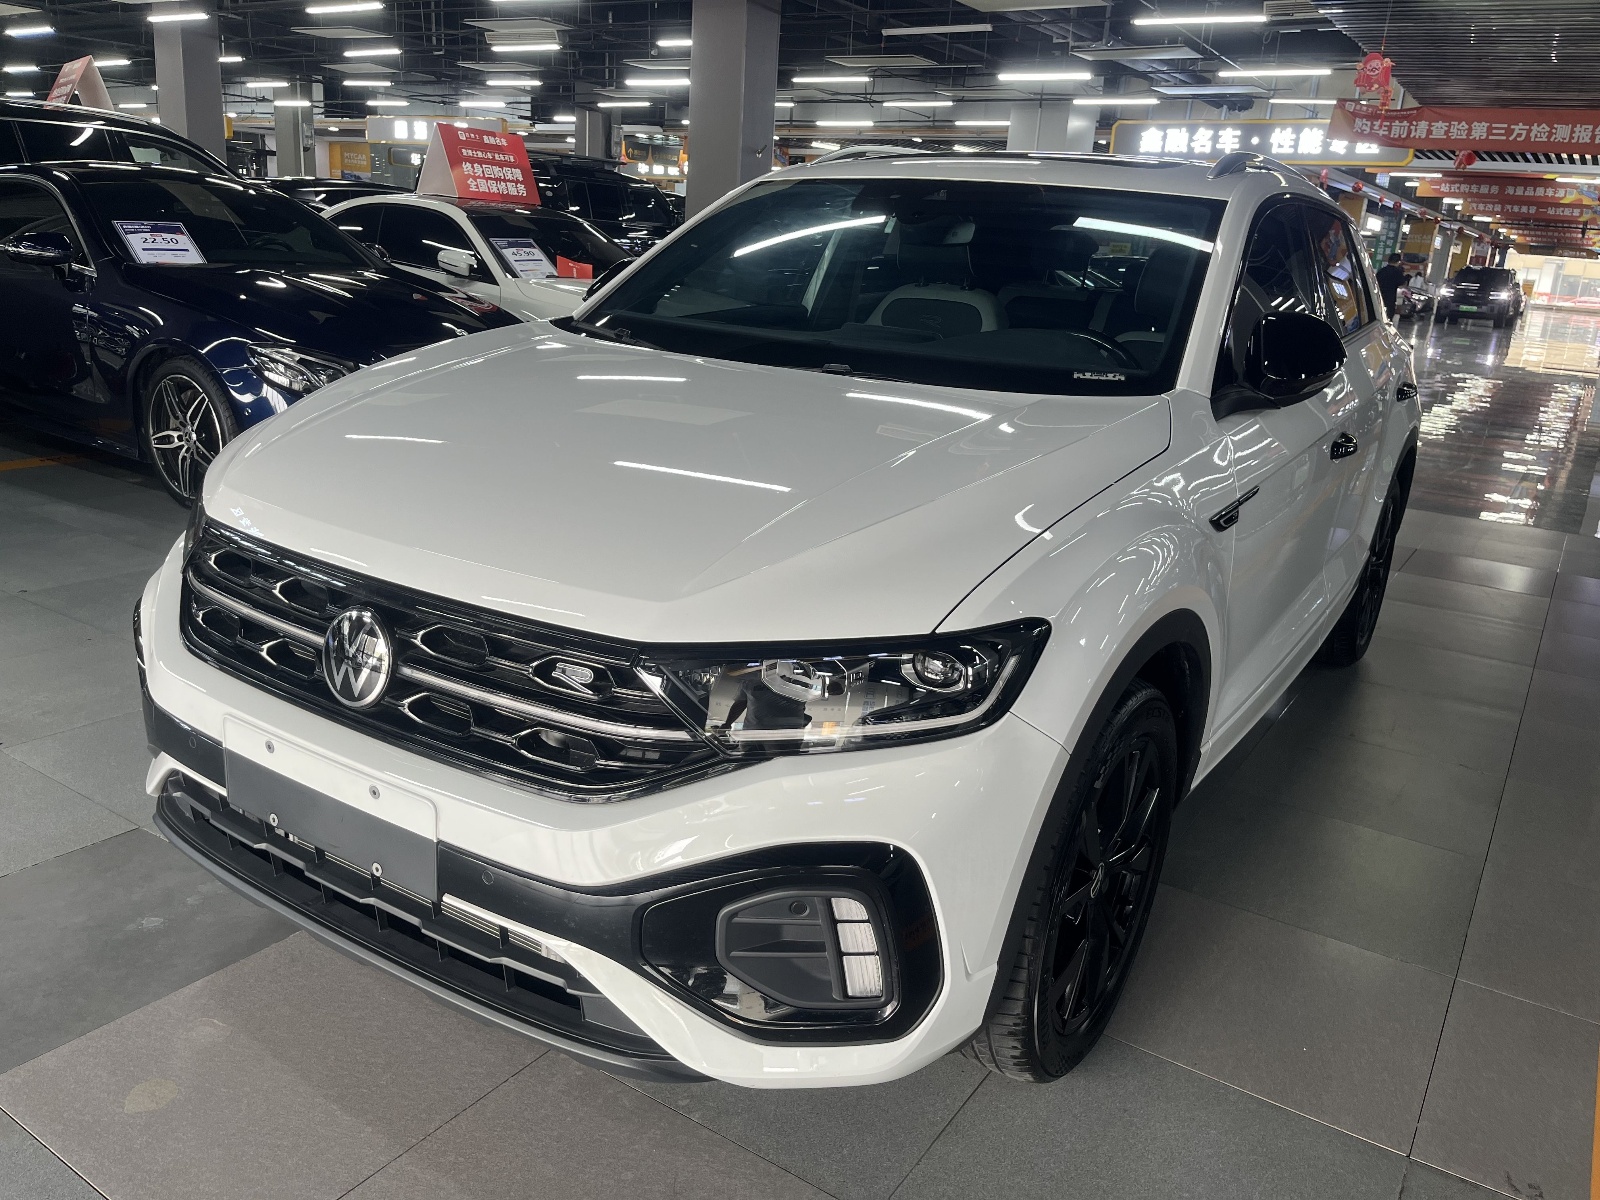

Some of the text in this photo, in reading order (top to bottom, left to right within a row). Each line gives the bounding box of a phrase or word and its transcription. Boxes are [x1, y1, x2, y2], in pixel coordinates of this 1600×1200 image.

[462, 161, 523, 181] 终身回购保障
[467, 177, 527, 197] 全国保修服务
[1431, 183, 1499, 195] 一站式购车服务
[141, 237, 179, 245] 22.50
